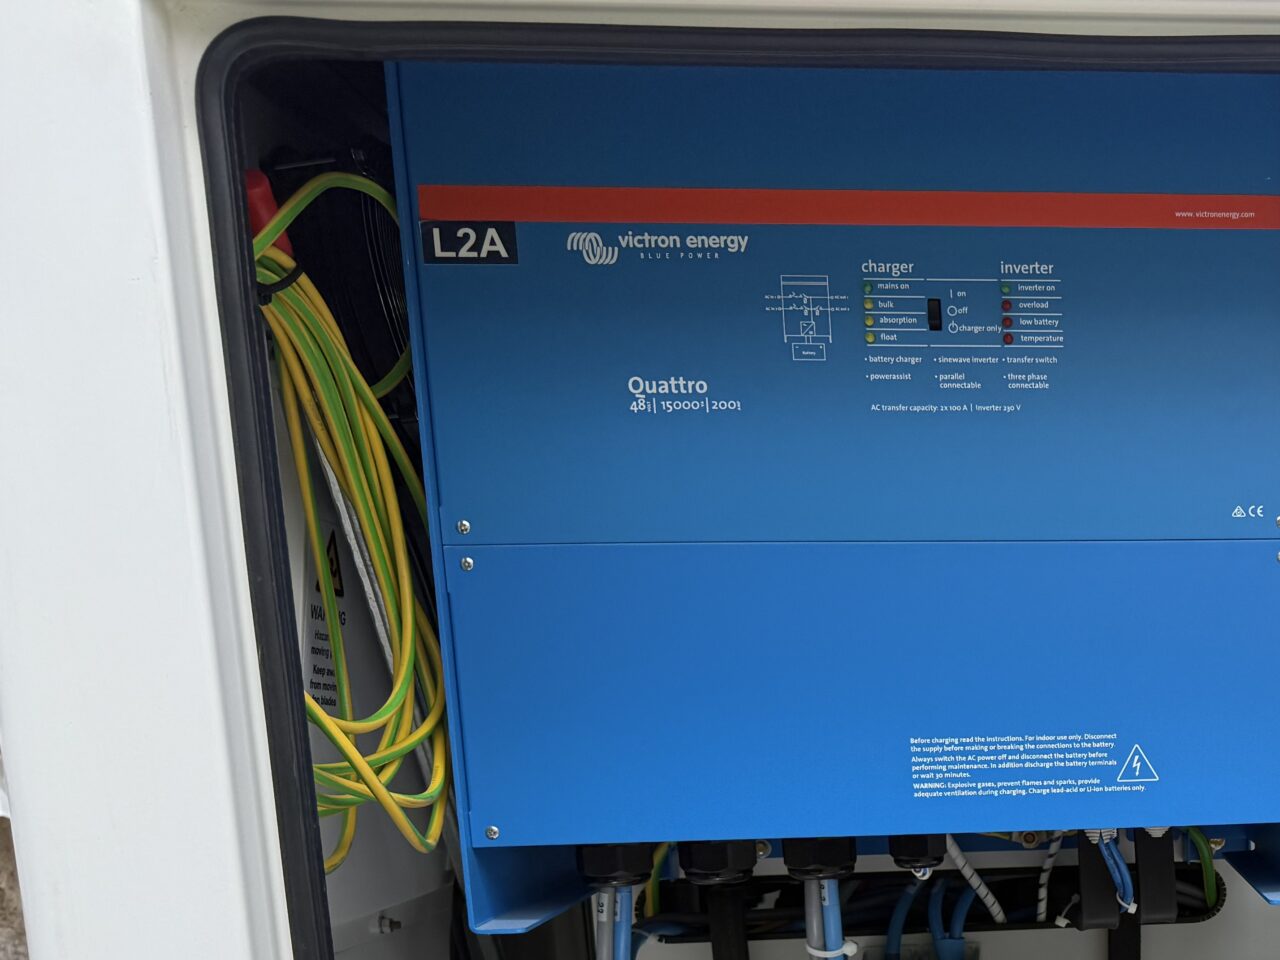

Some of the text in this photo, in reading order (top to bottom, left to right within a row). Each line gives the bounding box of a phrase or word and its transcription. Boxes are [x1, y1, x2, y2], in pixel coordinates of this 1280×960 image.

[432, 227, 508, 257] L2A
[618, 232, 748, 252] victron energy
[861, 259, 914, 276] charger
[1000, 260, 1053, 274] inverter
[879, 316, 917, 325] absorption
[1033, 318, 1058, 327] battery
[958, 324, 1001, 333] charger only
[1020, 335, 1063, 343] temperature
[868, 355, 921, 364] battery charger
[870, 372, 911, 381] powerassist
[939, 372, 964, 381] parallel
[1027, 372, 1047, 383] phase
[628, 376, 708, 399] Quattro
[313, 664, 326, 676] Keep
[922, 745, 943, 753] supply
[996, 743, 1024, 751] breaking
[1092, 740, 1114, 749] battery.
[911, 755, 933, 763] Always
[1065, 752, 1087, 760] battery
